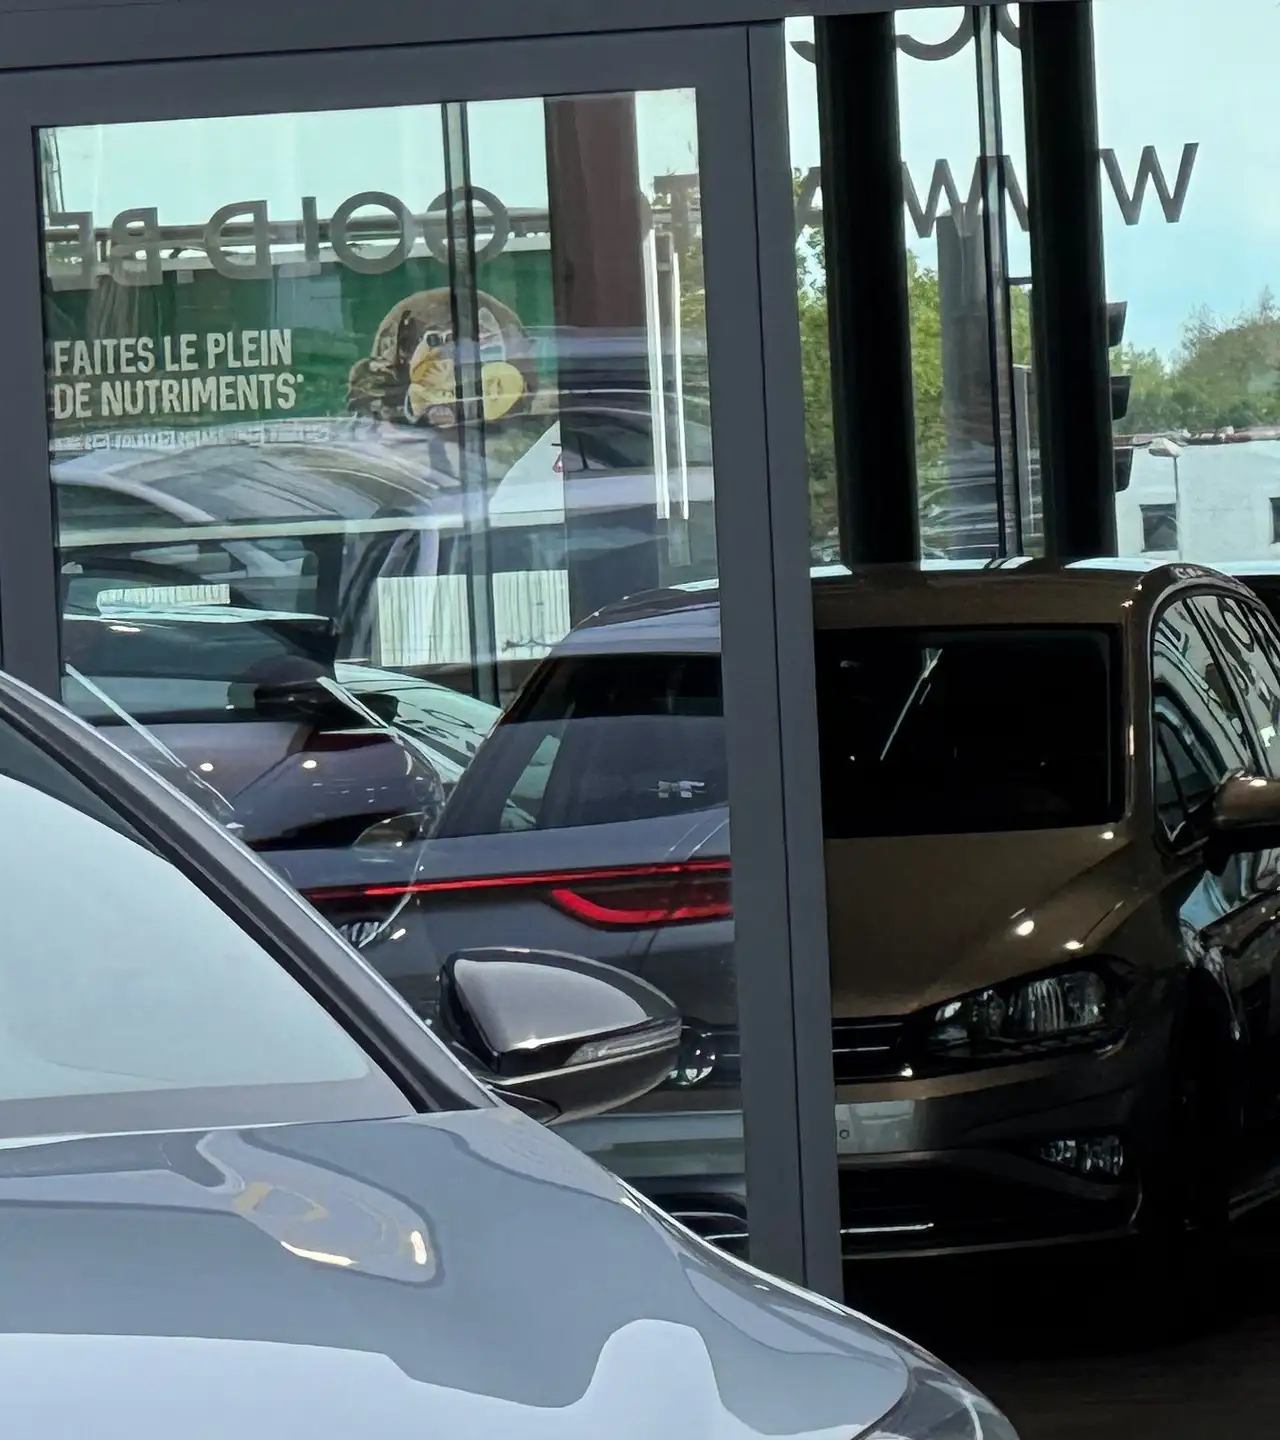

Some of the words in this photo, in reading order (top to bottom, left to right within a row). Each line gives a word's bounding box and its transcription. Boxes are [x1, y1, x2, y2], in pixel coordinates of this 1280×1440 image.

[52, 336, 156, 377] FAITES
[163, 333, 200, 372] LE
[206, 328, 293, 370] PLEIN
[53, 381, 92, 420] DE
